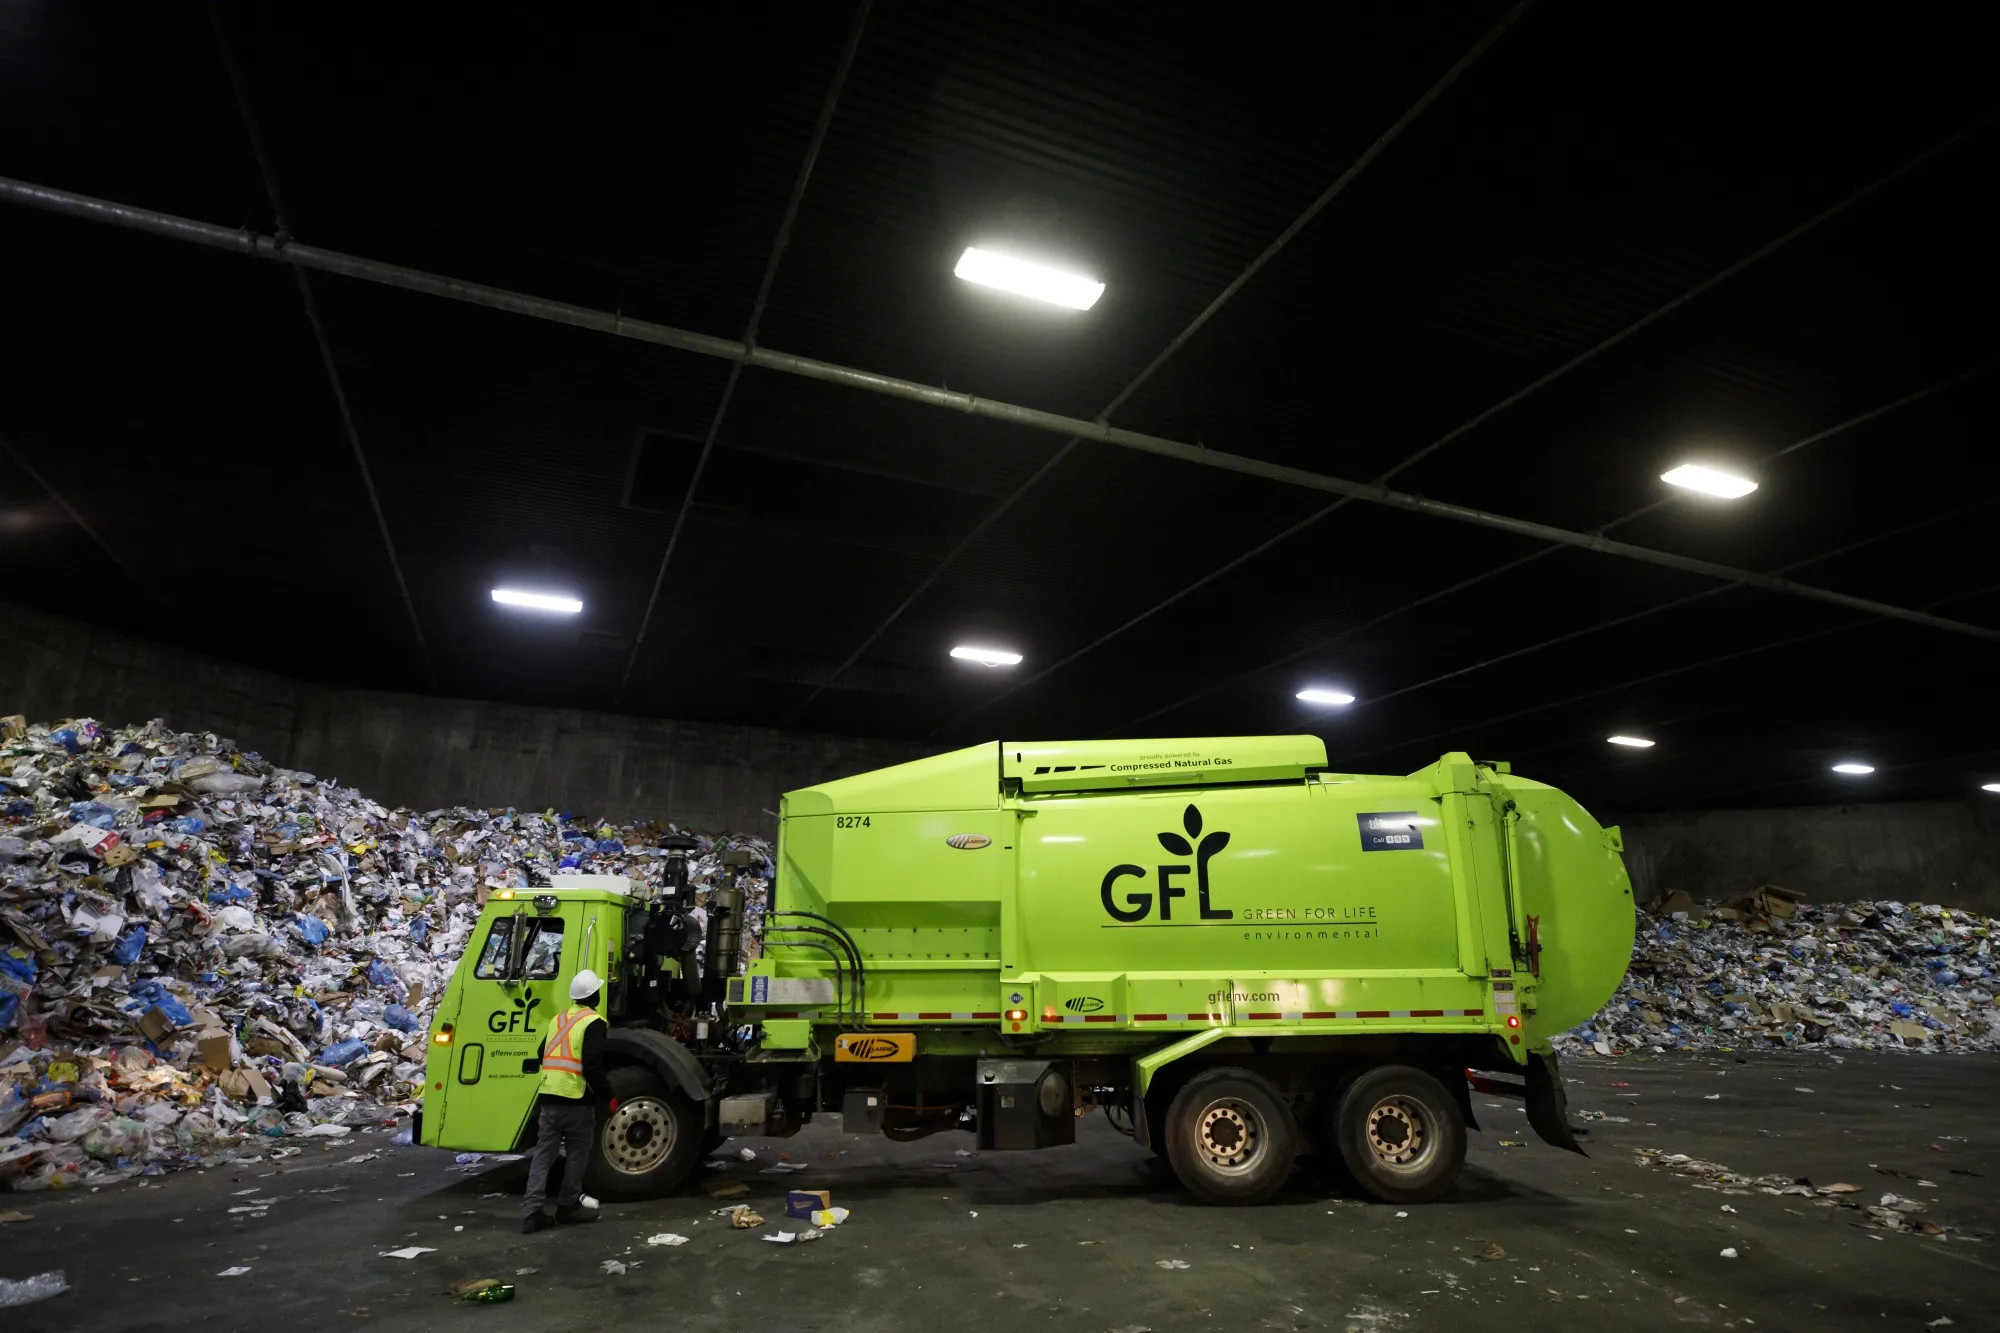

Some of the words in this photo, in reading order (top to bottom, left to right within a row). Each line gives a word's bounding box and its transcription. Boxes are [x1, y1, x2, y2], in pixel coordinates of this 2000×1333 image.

[1165, 751, 1191, 759] powered
[1110, 761, 1171, 772] Compressed
[1174, 758, 1211, 768] Natural
[1214, 757, 1233, 765] Gas
[836, 816, 871, 828] 8274
[1101, 831, 1233, 923] GFL
[1243, 908, 1296, 920] GREEN
[1305, 907, 1336, 919] FOR
[1344, 906, 1377, 918] LIFE
[1244, 928, 1378, 940] environmental
[1208, 991, 1280, 1004] gflenv.com
[488, 998, 541, 1033] GFL
[490, 1049, 528, 1057] gflenv.com
